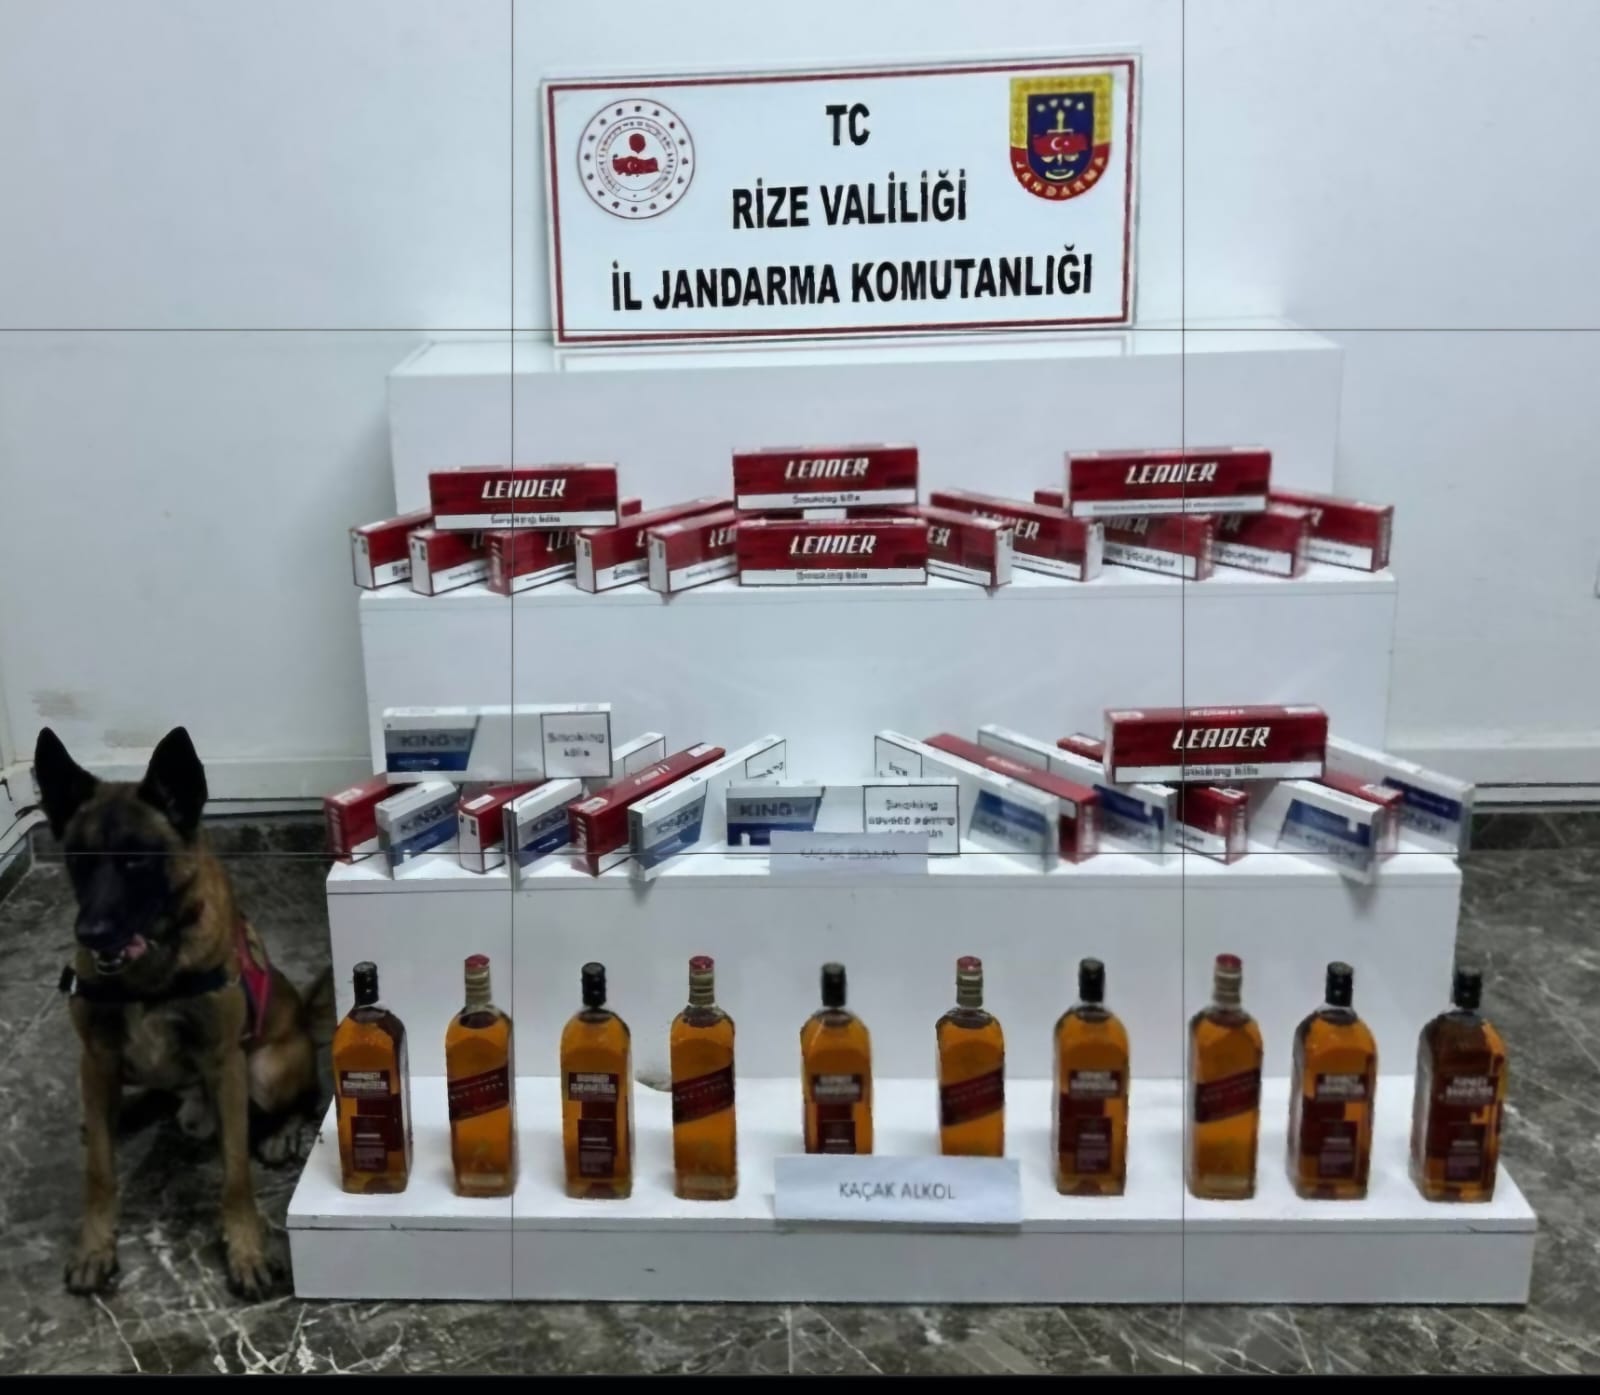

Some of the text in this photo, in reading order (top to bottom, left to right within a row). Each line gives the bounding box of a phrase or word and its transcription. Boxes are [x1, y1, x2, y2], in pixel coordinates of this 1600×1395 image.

[825, 104, 870, 146] TC
[732, 169, 967, 230] RİZE VALİLİĞİ
[612, 244, 1092, 311] İL JANDARMA KOMUTANLIĞI
[784, 457, 870, 480] LEADER
[1125, 462, 1218, 484] LEADER
[481, 478, 567, 499] LEADER
[790, 534, 877, 555] LEADER
[1172, 726, 1271, 750] LEADER
[740, 803, 793, 816] KING
[839, 1181, 957, 1202] KAÇAK ALKOL
